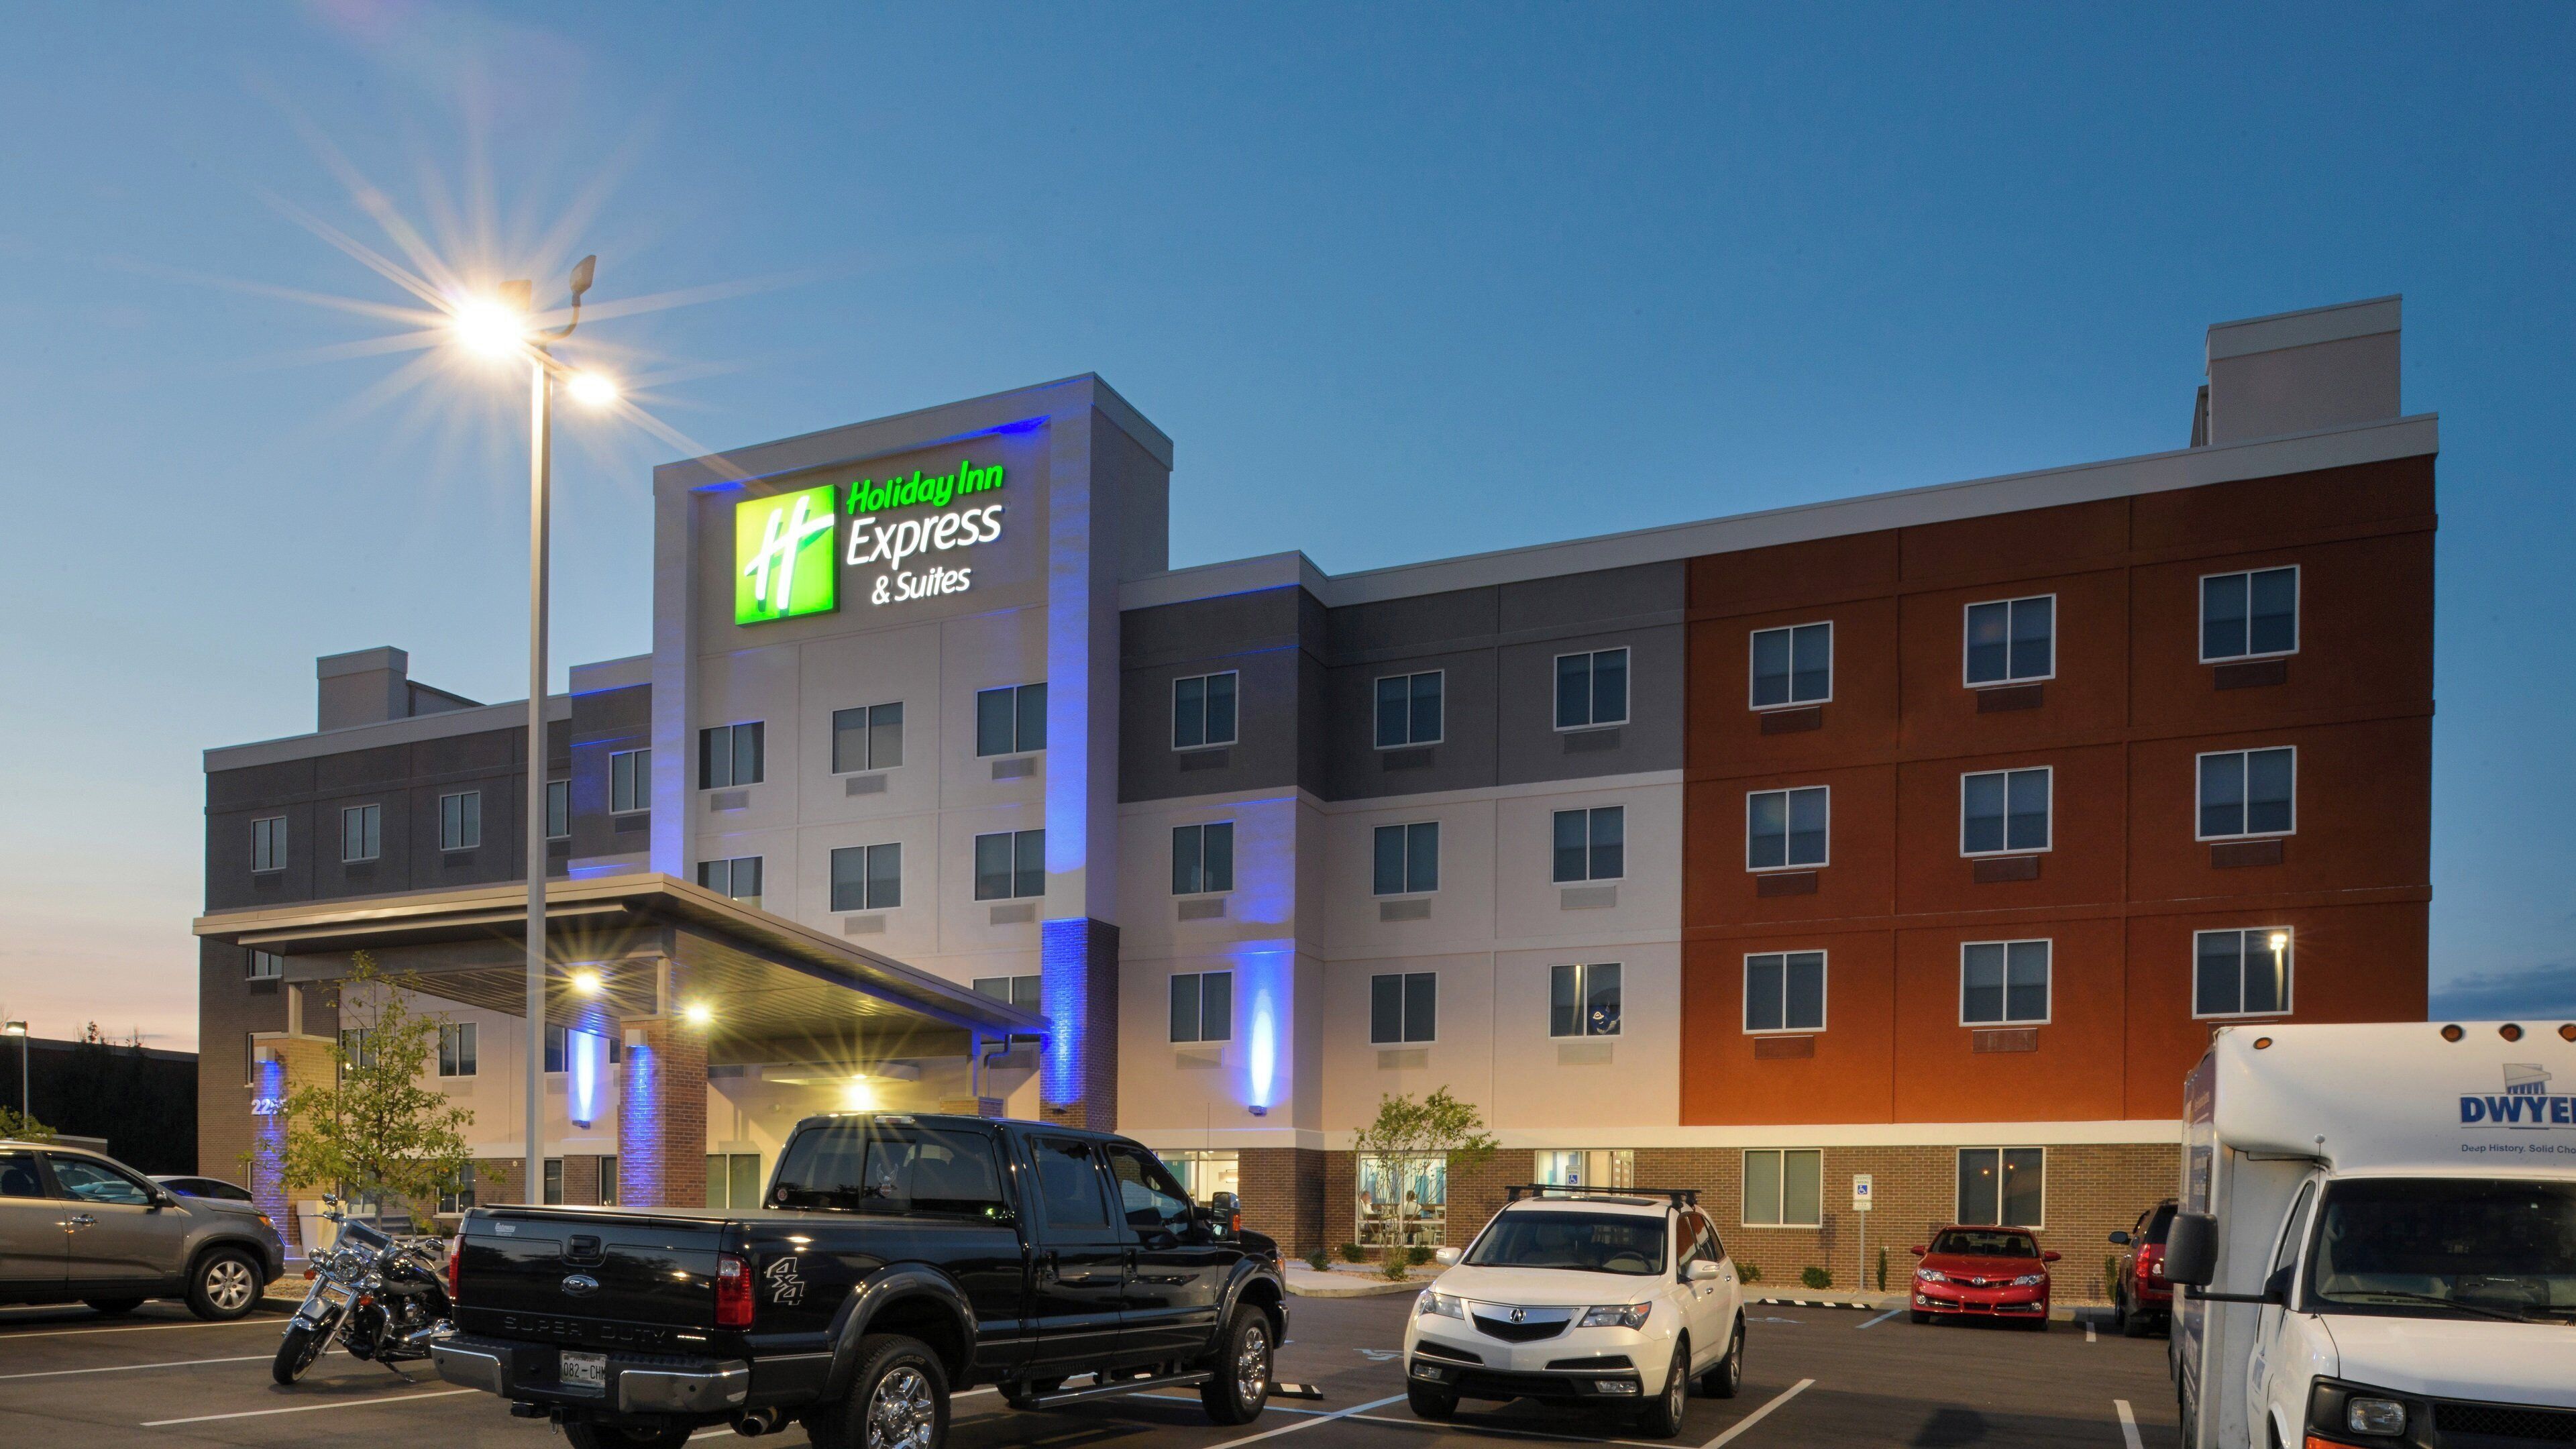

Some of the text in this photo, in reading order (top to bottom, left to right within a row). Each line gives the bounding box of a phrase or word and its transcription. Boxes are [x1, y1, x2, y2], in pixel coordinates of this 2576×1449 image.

[847, 461, 1004, 515] Holiday Inn
[847, 504, 1002, 570] Express
[872, 568, 971, 605] & Suites
[2460, 1096, 2576, 1124] DWYE
[2461, 1144, 2486, 1153] Deep
[2489, 1144, 2526, 1153] History.
[2529, 1144, 2554, 1153] Solid
[504, 1316, 666, 1343] SUPER DUTY
